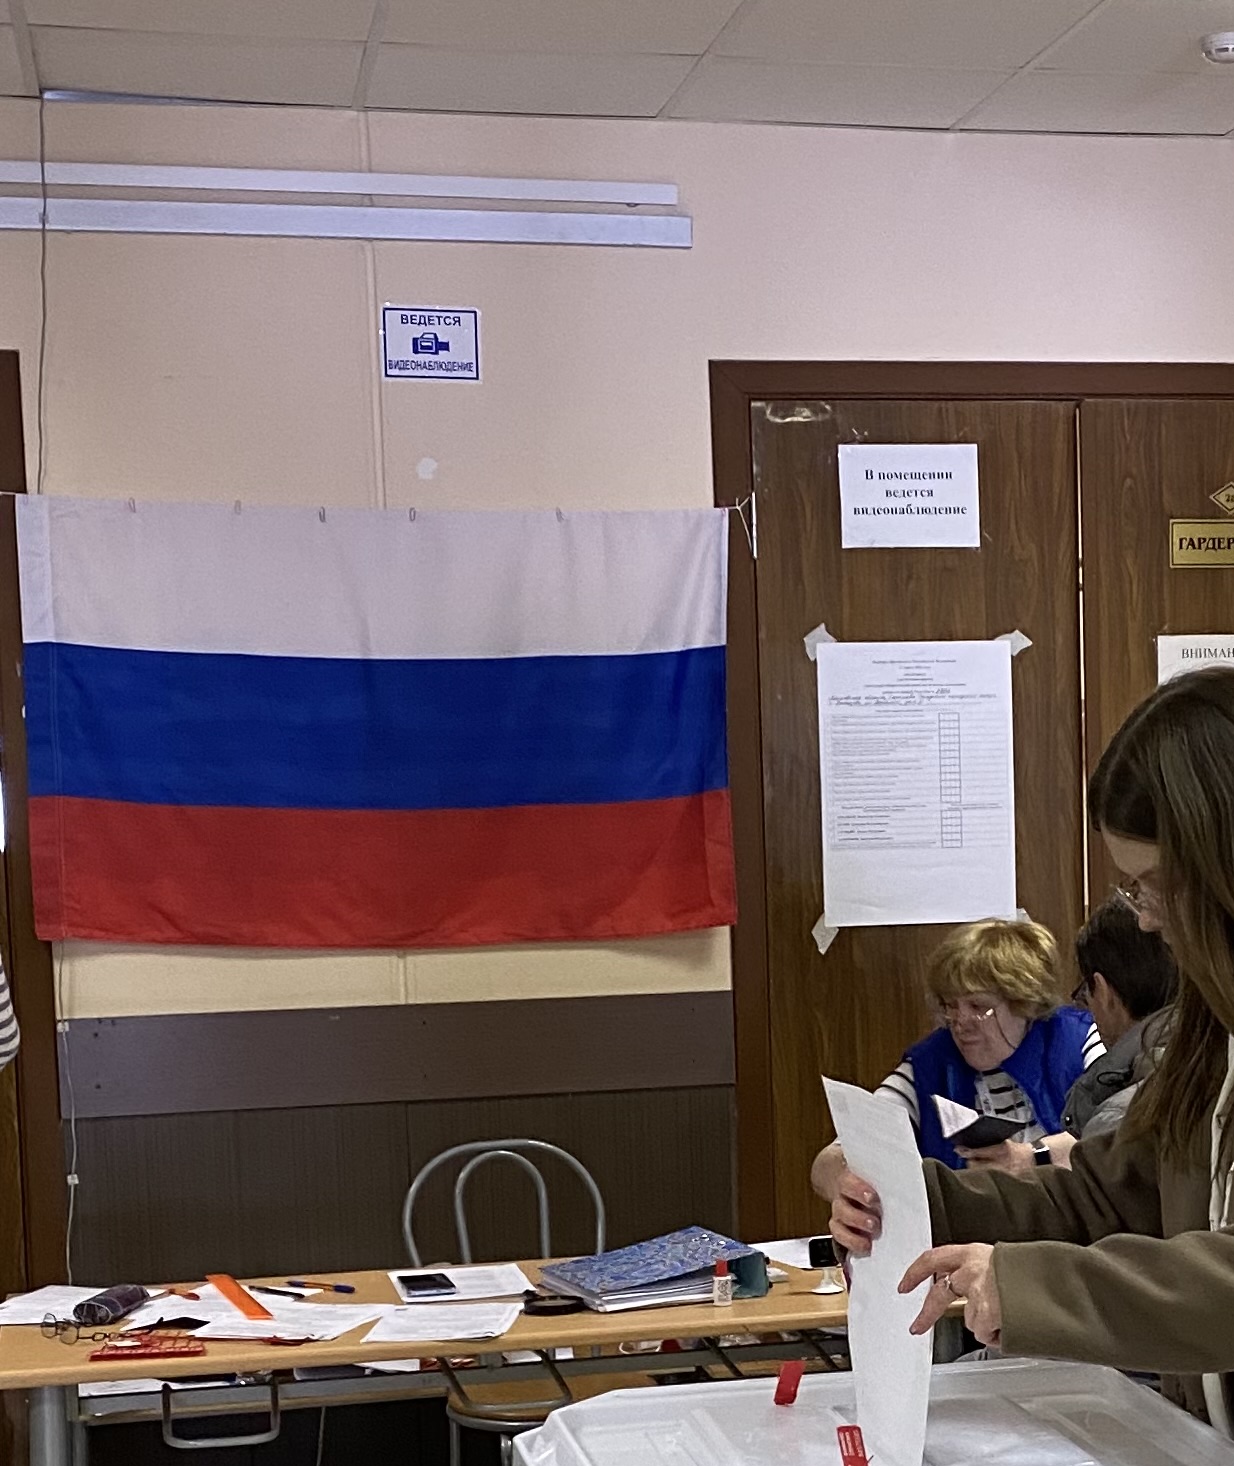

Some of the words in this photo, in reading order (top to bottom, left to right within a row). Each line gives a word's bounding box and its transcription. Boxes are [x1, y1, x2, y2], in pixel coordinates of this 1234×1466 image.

[401, 314, 461, 326] ВЕДЕТСЯ
[388, 360, 474, 372] ВИДЕОНАБЛЮДЕНИЕ
[865, 469, 874, 480] В
[878, 471, 953, 480] помещении
[885, 489, 934, 498] ведется
[853, 504, 968, 516] видеонаблюдение
